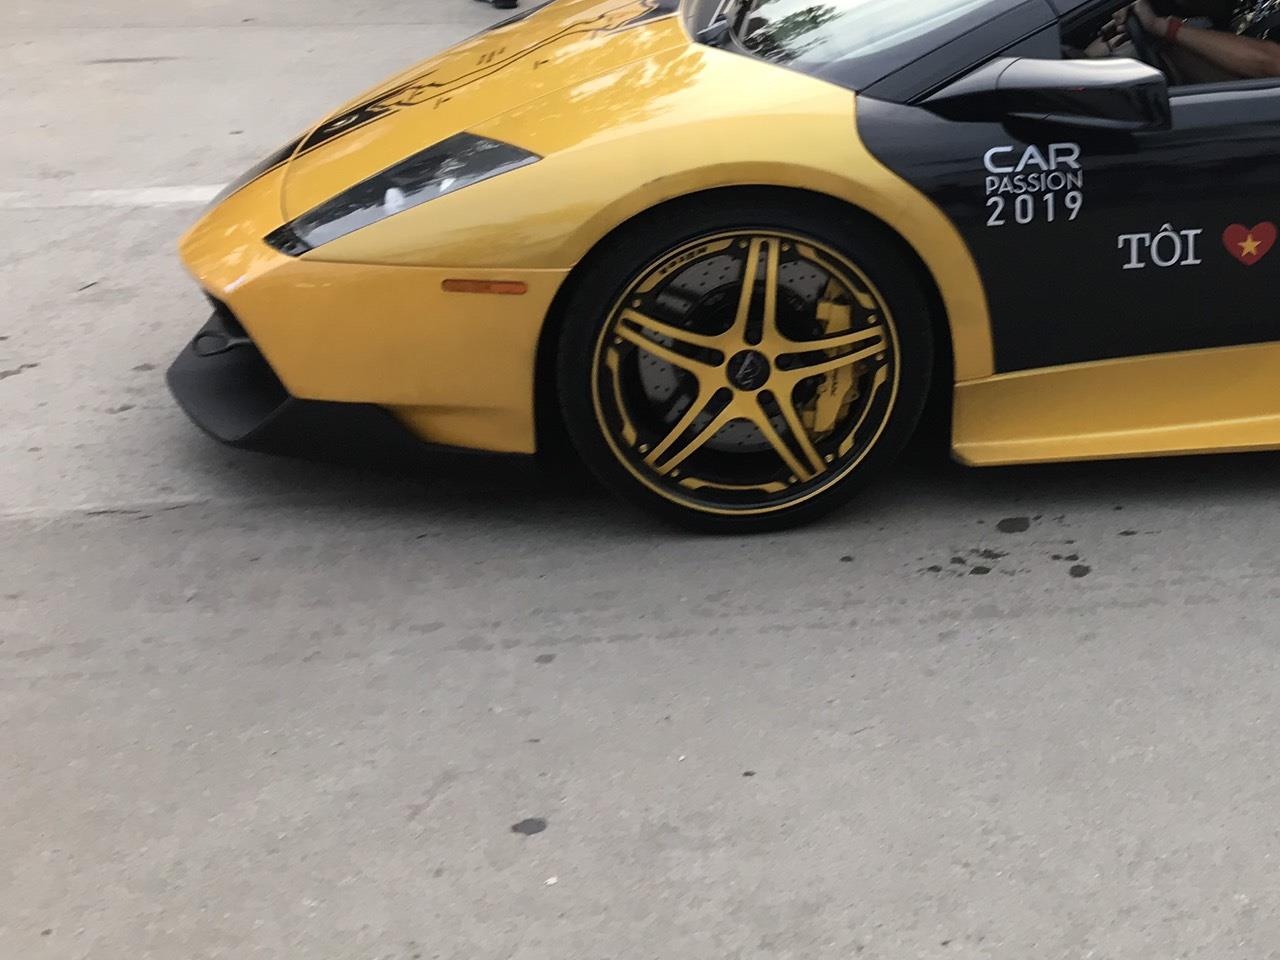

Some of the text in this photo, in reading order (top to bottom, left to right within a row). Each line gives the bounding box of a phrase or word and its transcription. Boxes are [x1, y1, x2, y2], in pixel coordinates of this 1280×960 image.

[983, 142, 1082, 174] CAR
[985, 169, 1083, 196] PASSION
[985, 190, 1083, 227] 2019
[1117, 222, 1203, 269] TÔI
